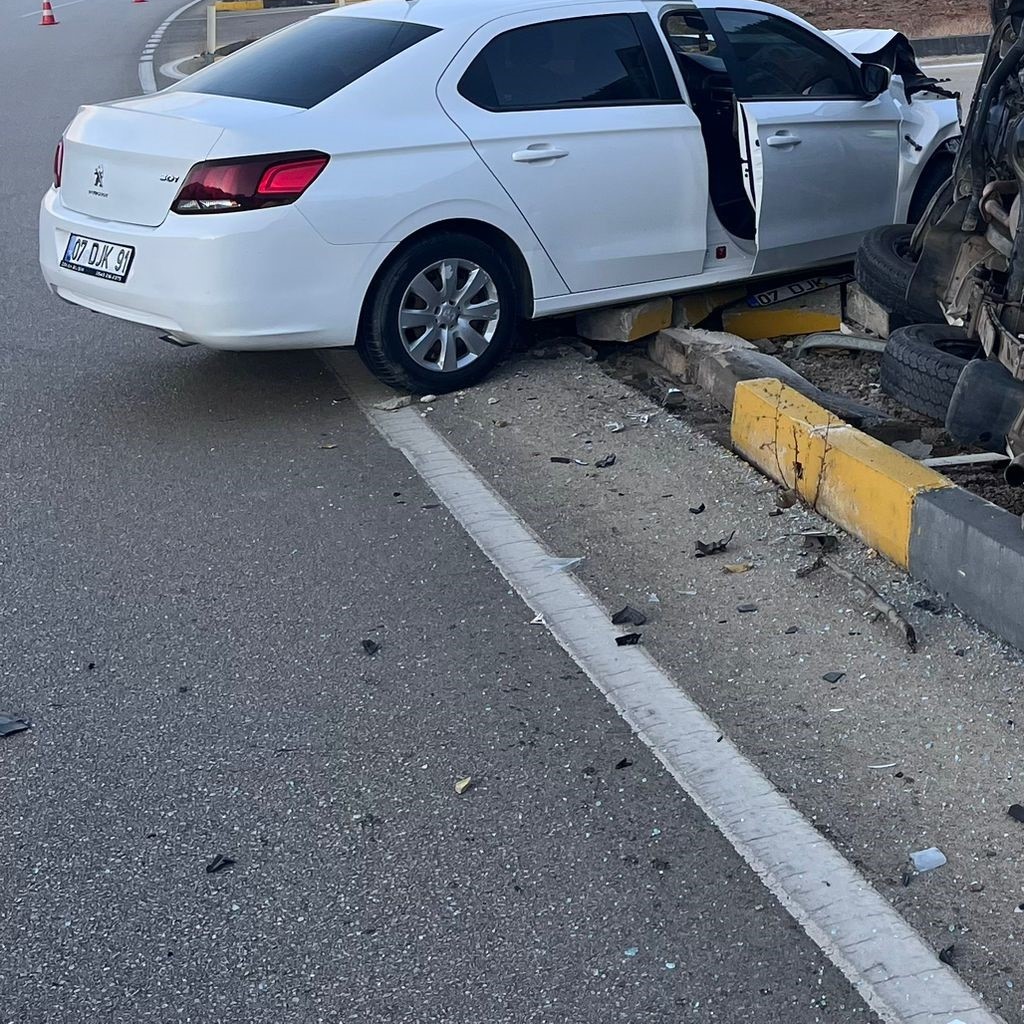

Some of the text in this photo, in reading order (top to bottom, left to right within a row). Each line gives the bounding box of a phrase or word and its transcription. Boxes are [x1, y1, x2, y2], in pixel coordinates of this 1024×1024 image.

[72, 238, 88, 261] 07
[88, 242, 114, 269] DJK
[114, 249, 130, 273] 91
[758, 289, 778, 305] 07
